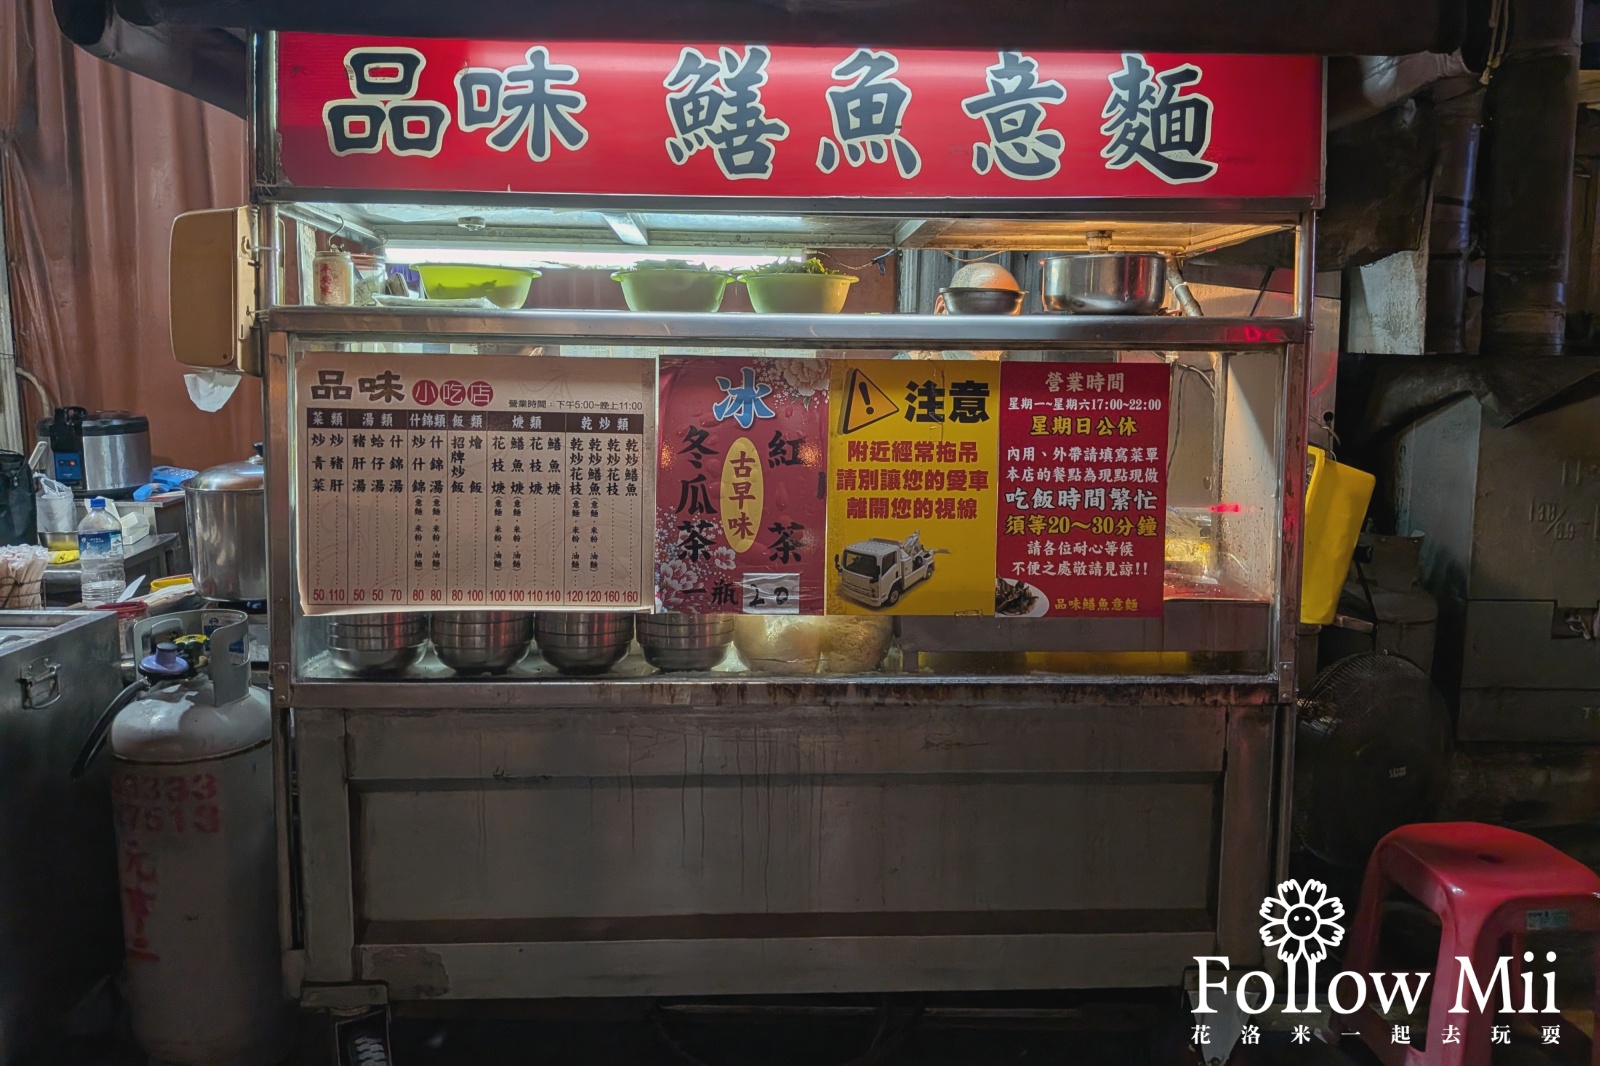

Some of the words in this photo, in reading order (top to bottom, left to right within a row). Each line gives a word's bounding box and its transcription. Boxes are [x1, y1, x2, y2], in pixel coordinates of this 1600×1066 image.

[323, 45, 589, 162] 品味
[310, 370, 406, 404] 品味
[412, 379, 494, 407] 小吃店
[1045, 372, 1125, 393] 營業時間
[712, 367, 776, 429] 冰
[904, 380, 990, 423] 注意
[312, 412, 343, 426] 菜類
[362, 412, 393, 427] 湯類
[409, 413, 446, 427] 什錦類
[453, 414, 483, 428] 飯類
[581, 416, 629, 431] 乾炒類
[1030, 415, 1138, 436] 星期日公休
[848, 441, 979, 463] 附近經常拖吊
[311, 433, 326, 492] 炒青菜
[330, 434, 344, 492] 炒豬肝
[352, 434, 366, 493] 豬肝湯
[371, 434, 385, 493] 蛤仔湯
[389, 435, 404, 493] 什錦湯
[412, 435, 425, 494] 炒什錦
[430, 436, 443, 494] 什錦湯
[451, 436, 465, 493] 招牌炒飯
[836, 469, 988, 491] 請別讓您的愛車
[1006, 466, 1159, 483] 本店的餐點為現點現做
[676, 425, 719, 562] 冬瓜茶
[728, 451, 755, 539] 古早味
[768, 430, 806, 564] 紅茶
[1005, 487, 1158, 511] 吃飯時間繁忙
[847, 497, 978, 519] 離開您的視線
[1027, 541, 1134, 556] 請各位耐心等候
[313, 589, 324, 601] 50
[329, 589, 344, 601] 110
[353, 590, 365, 601] 50
[372, 590, 383, 601] 50
[391, 590, 402, 601] 70
[413, 590, 424, 601] 80
[431, 590, 441, 601] 80
[452, 590, 463, 601] 80
[467, 590, 483, 601] 100
[490, 590, 505, 601] 100
[509, 590, 524, 601] 100
[527, 590, 542, 601] 110
[546, 590, 560, 601] 110
[567, 591, 583, 602] 120
[586, 591, 601, 602] 120
[604, 591, 619, 602] 160
[622, 591, 638, 602] 160
[682, 579, 739, 605] 一瓶
